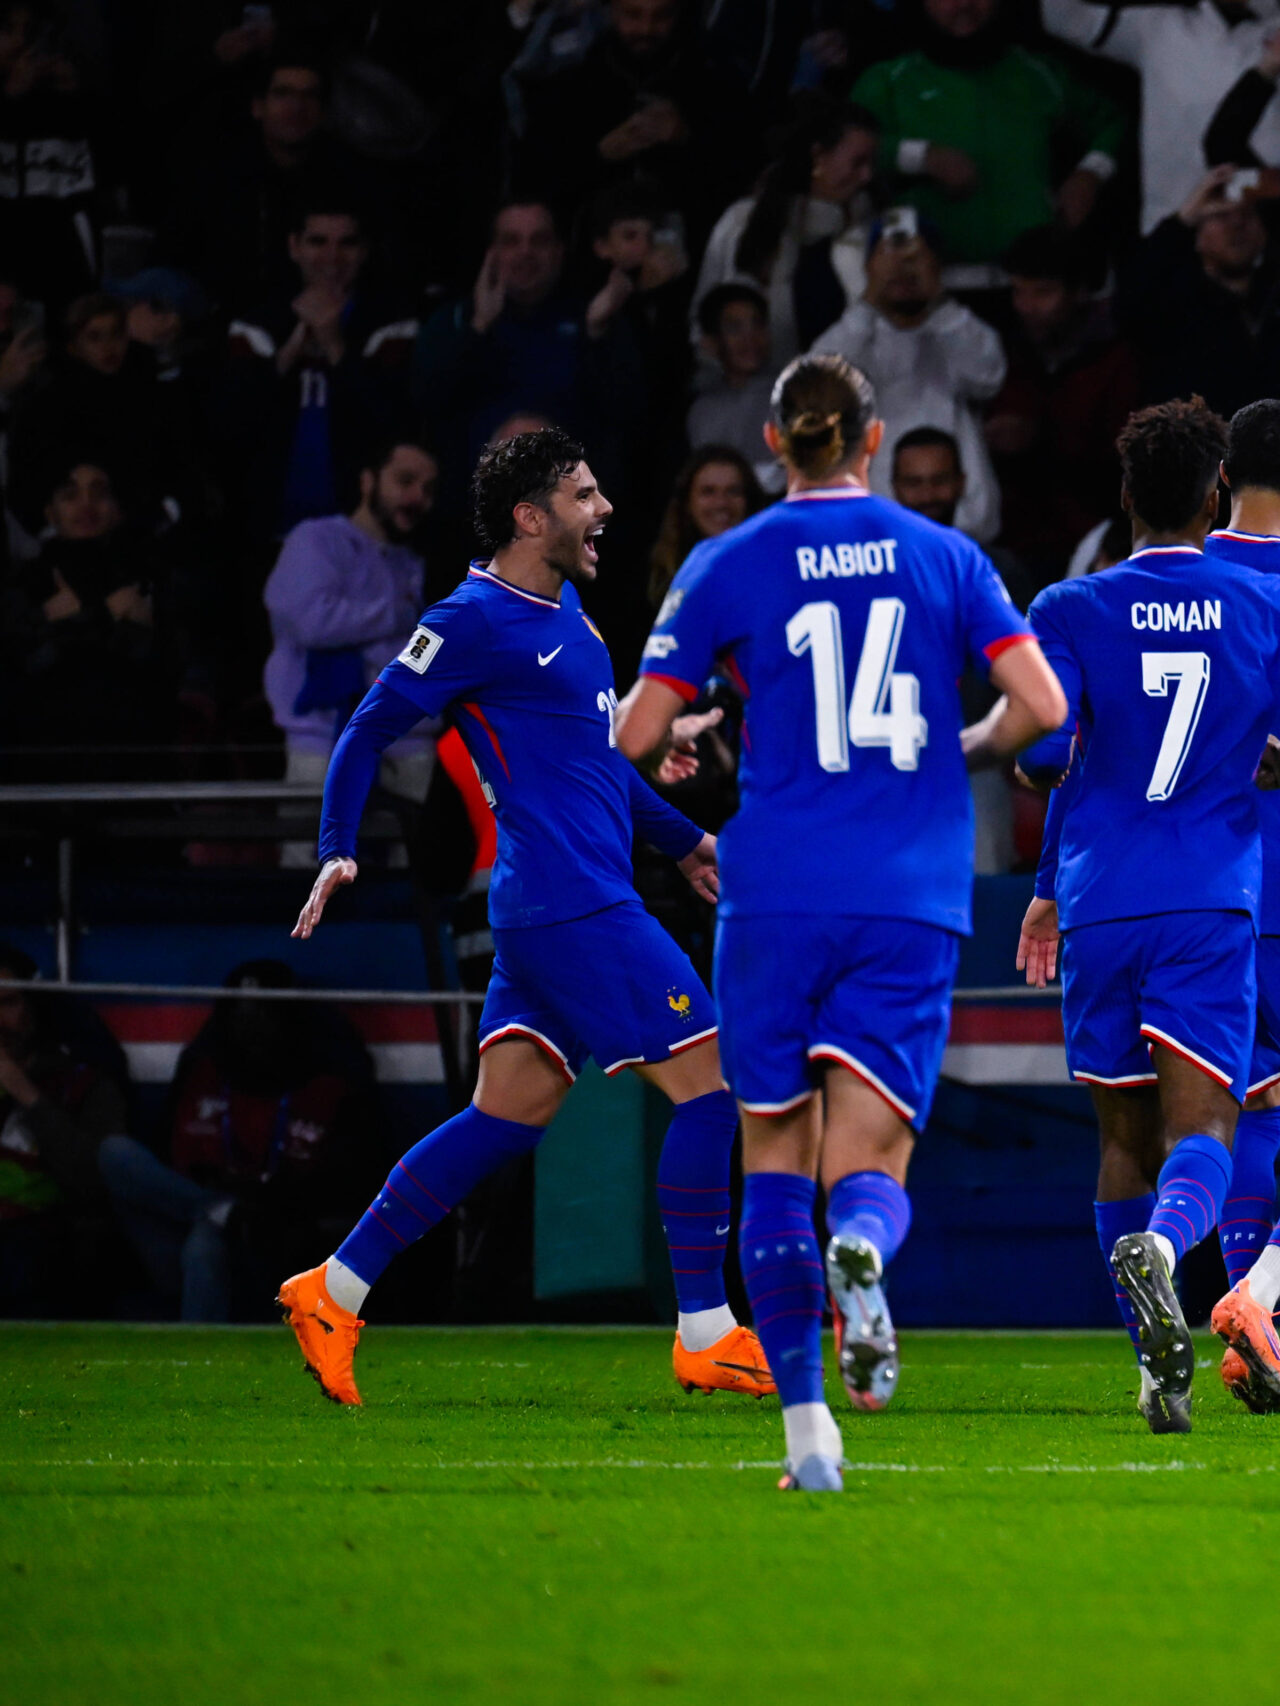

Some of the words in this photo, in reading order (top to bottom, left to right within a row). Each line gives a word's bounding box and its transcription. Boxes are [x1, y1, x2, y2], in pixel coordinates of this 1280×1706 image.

[796, 539, 897, 581] RABIOT
[1131, 599, 1222, 632] COMAN
[785, 597, 928, 772] 14
[1141, 651, 1210, 801] 7
